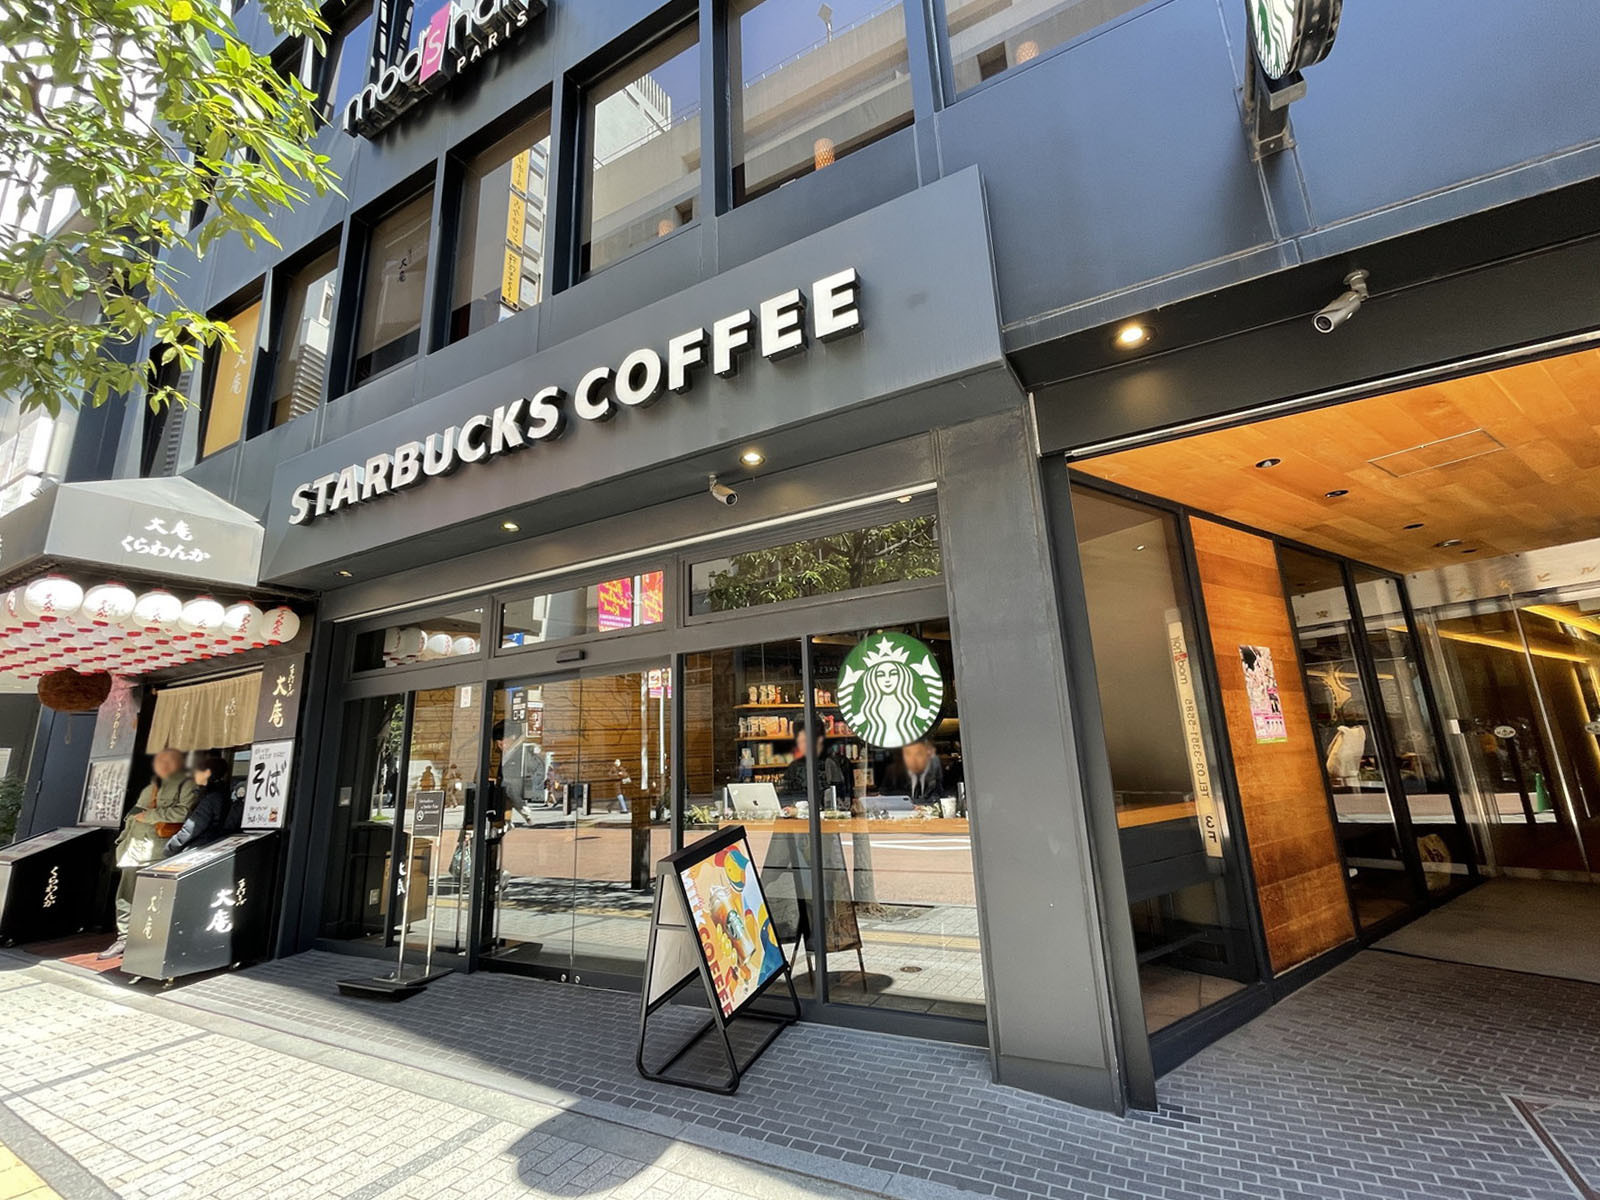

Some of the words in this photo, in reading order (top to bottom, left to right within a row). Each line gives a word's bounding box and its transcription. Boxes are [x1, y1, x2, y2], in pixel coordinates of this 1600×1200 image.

[457, 10, 527, 73] PARIS
[288, 386, 562, 525] STARBUCKS
[574, 267, 859, 421] COFFEE
[121, 535, 211, 562] くらわんか
[268, 676, 288, 728] 大庵
[252, 760, 287, 802] そば
[43, 866, 59, 908] くらわんか
[206, 889, 236, 933] 大庵
[699, 927, 734, 1018] COFFEE
